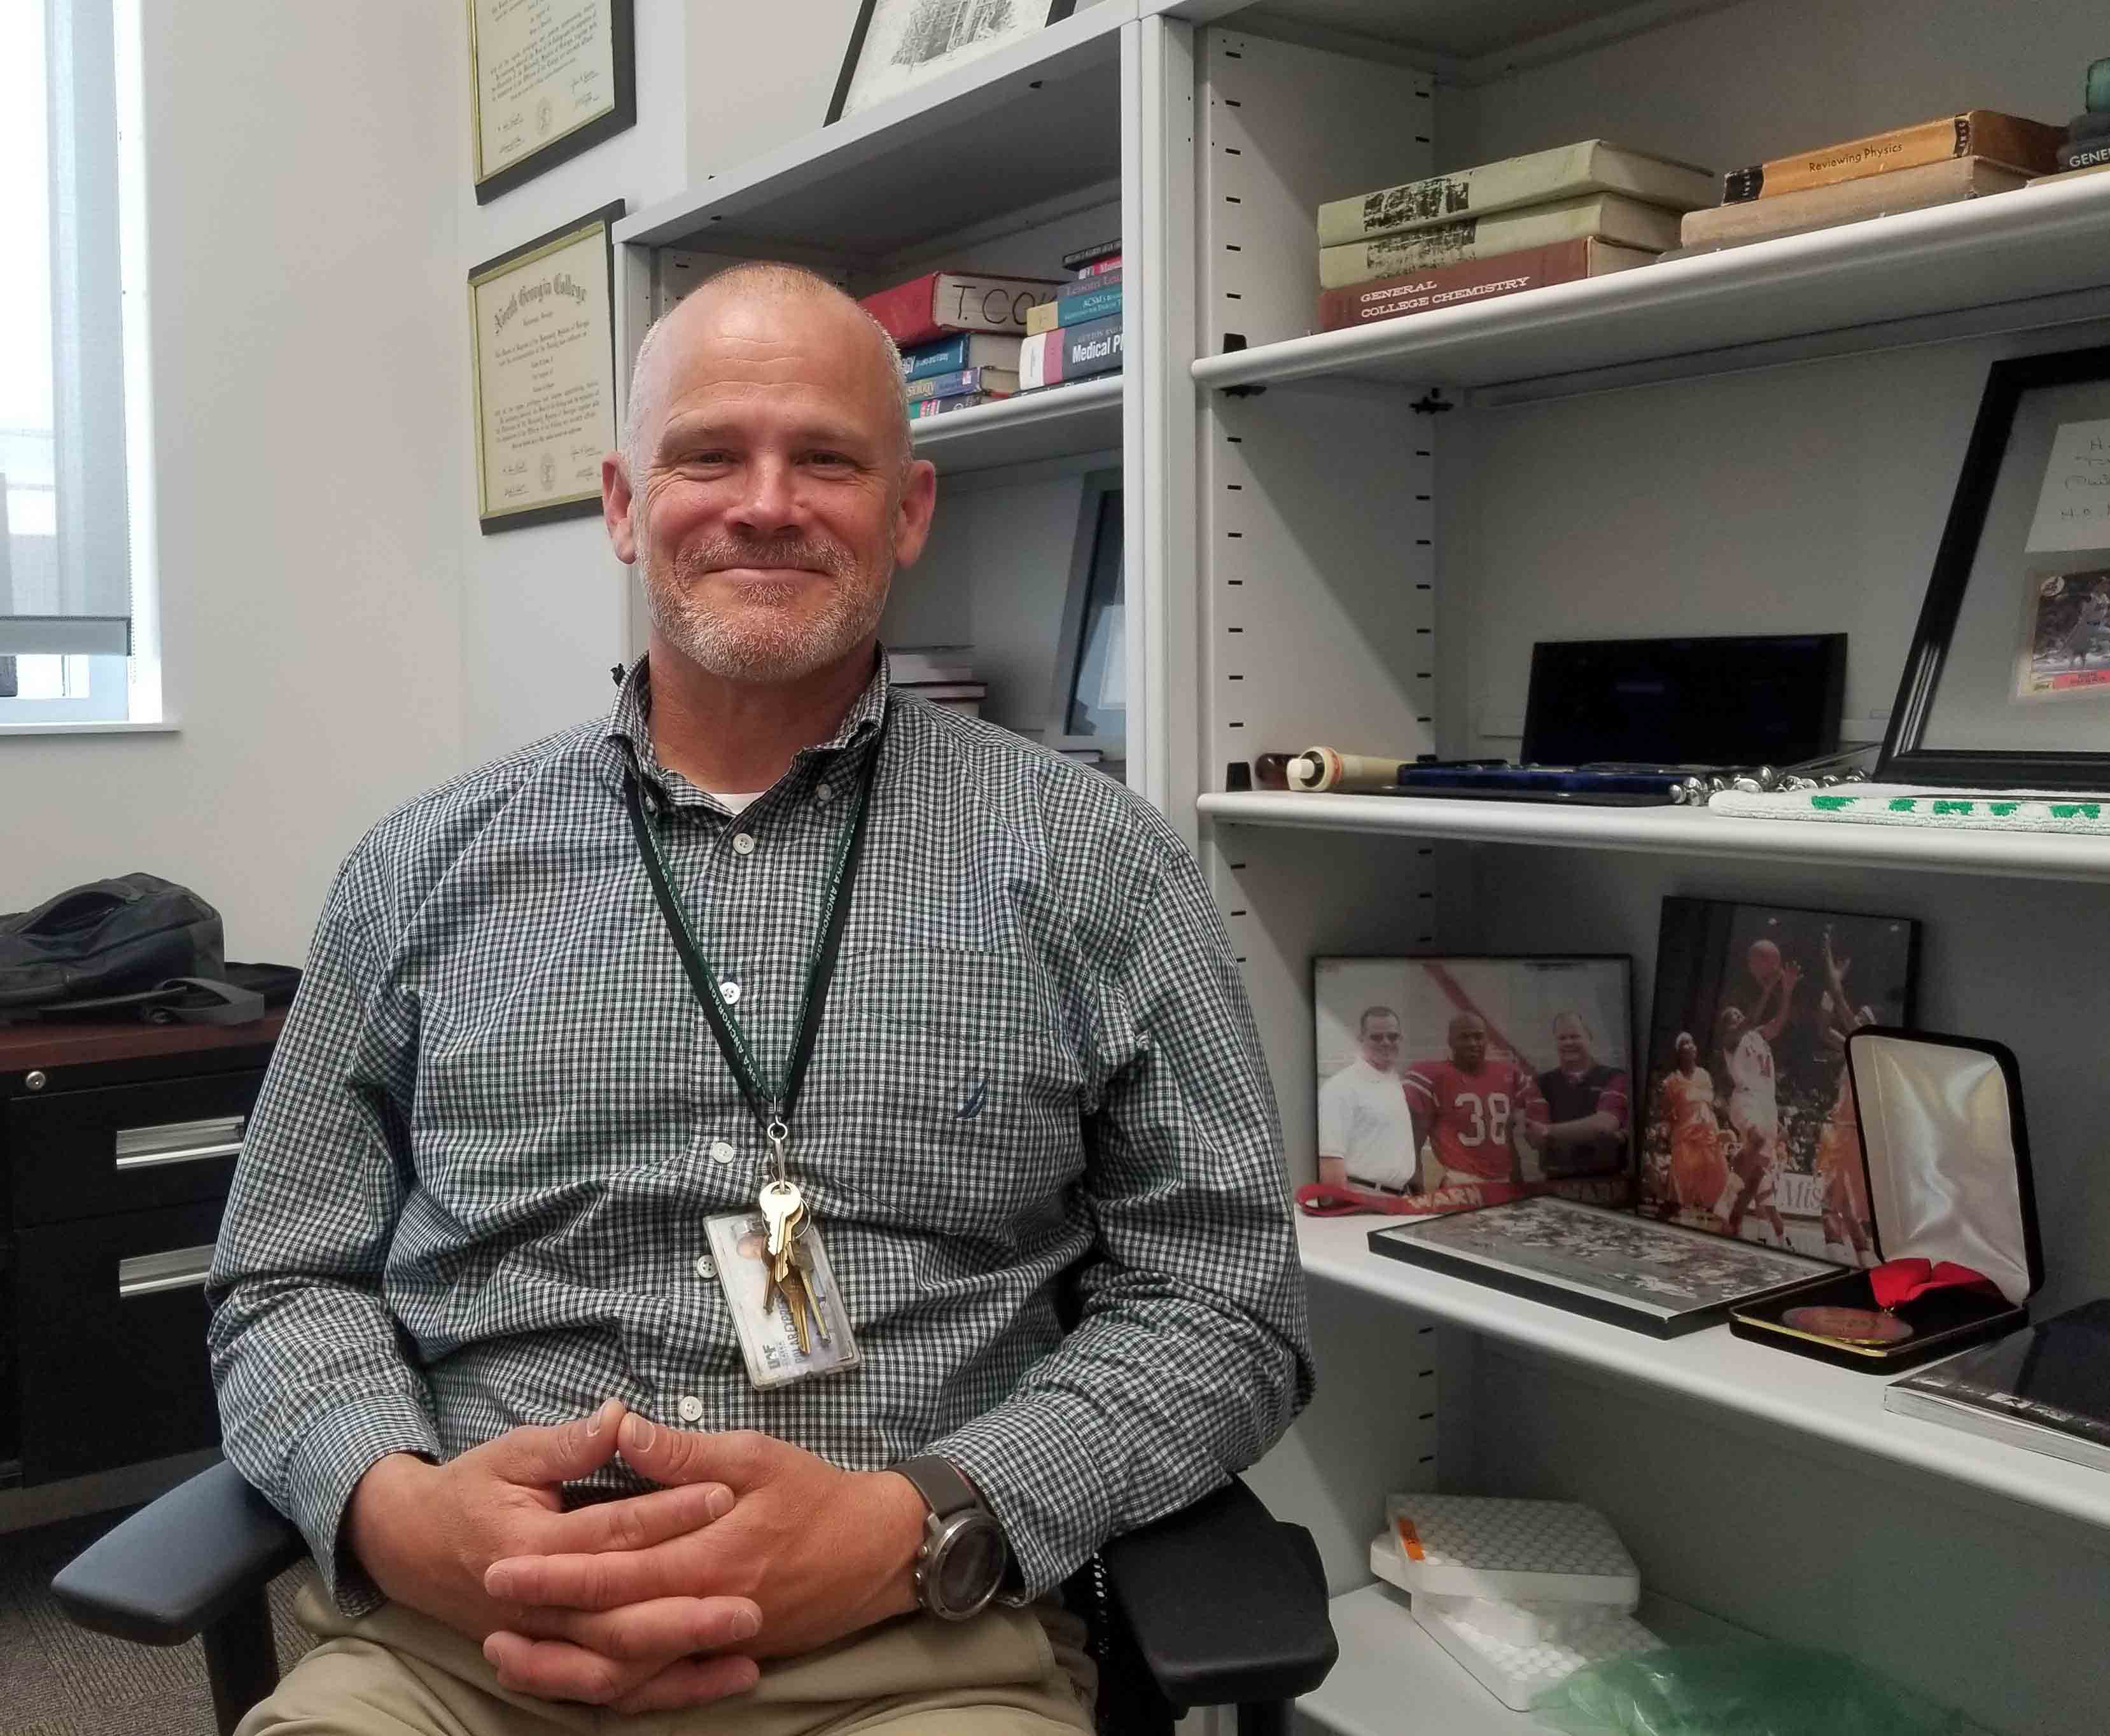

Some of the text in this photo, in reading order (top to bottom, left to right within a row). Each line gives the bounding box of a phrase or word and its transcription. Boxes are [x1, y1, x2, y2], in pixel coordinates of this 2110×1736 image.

[1809, 144, 1903, 172] Reviewing Physics
[2069, 148, 2110, 167] GENE
[1360, 281, 1437, 302] GENERAL
[1362, 276, 1530, 318] COLLEGE CHEMISTRY
[1072, 337, 1111, 363] Medical
[812, 886, 839, 961] ANCHORAGE
[707, 976, 743, 1053] ANCHORAGE
[1455, 1092, 1509, 1145] 38
